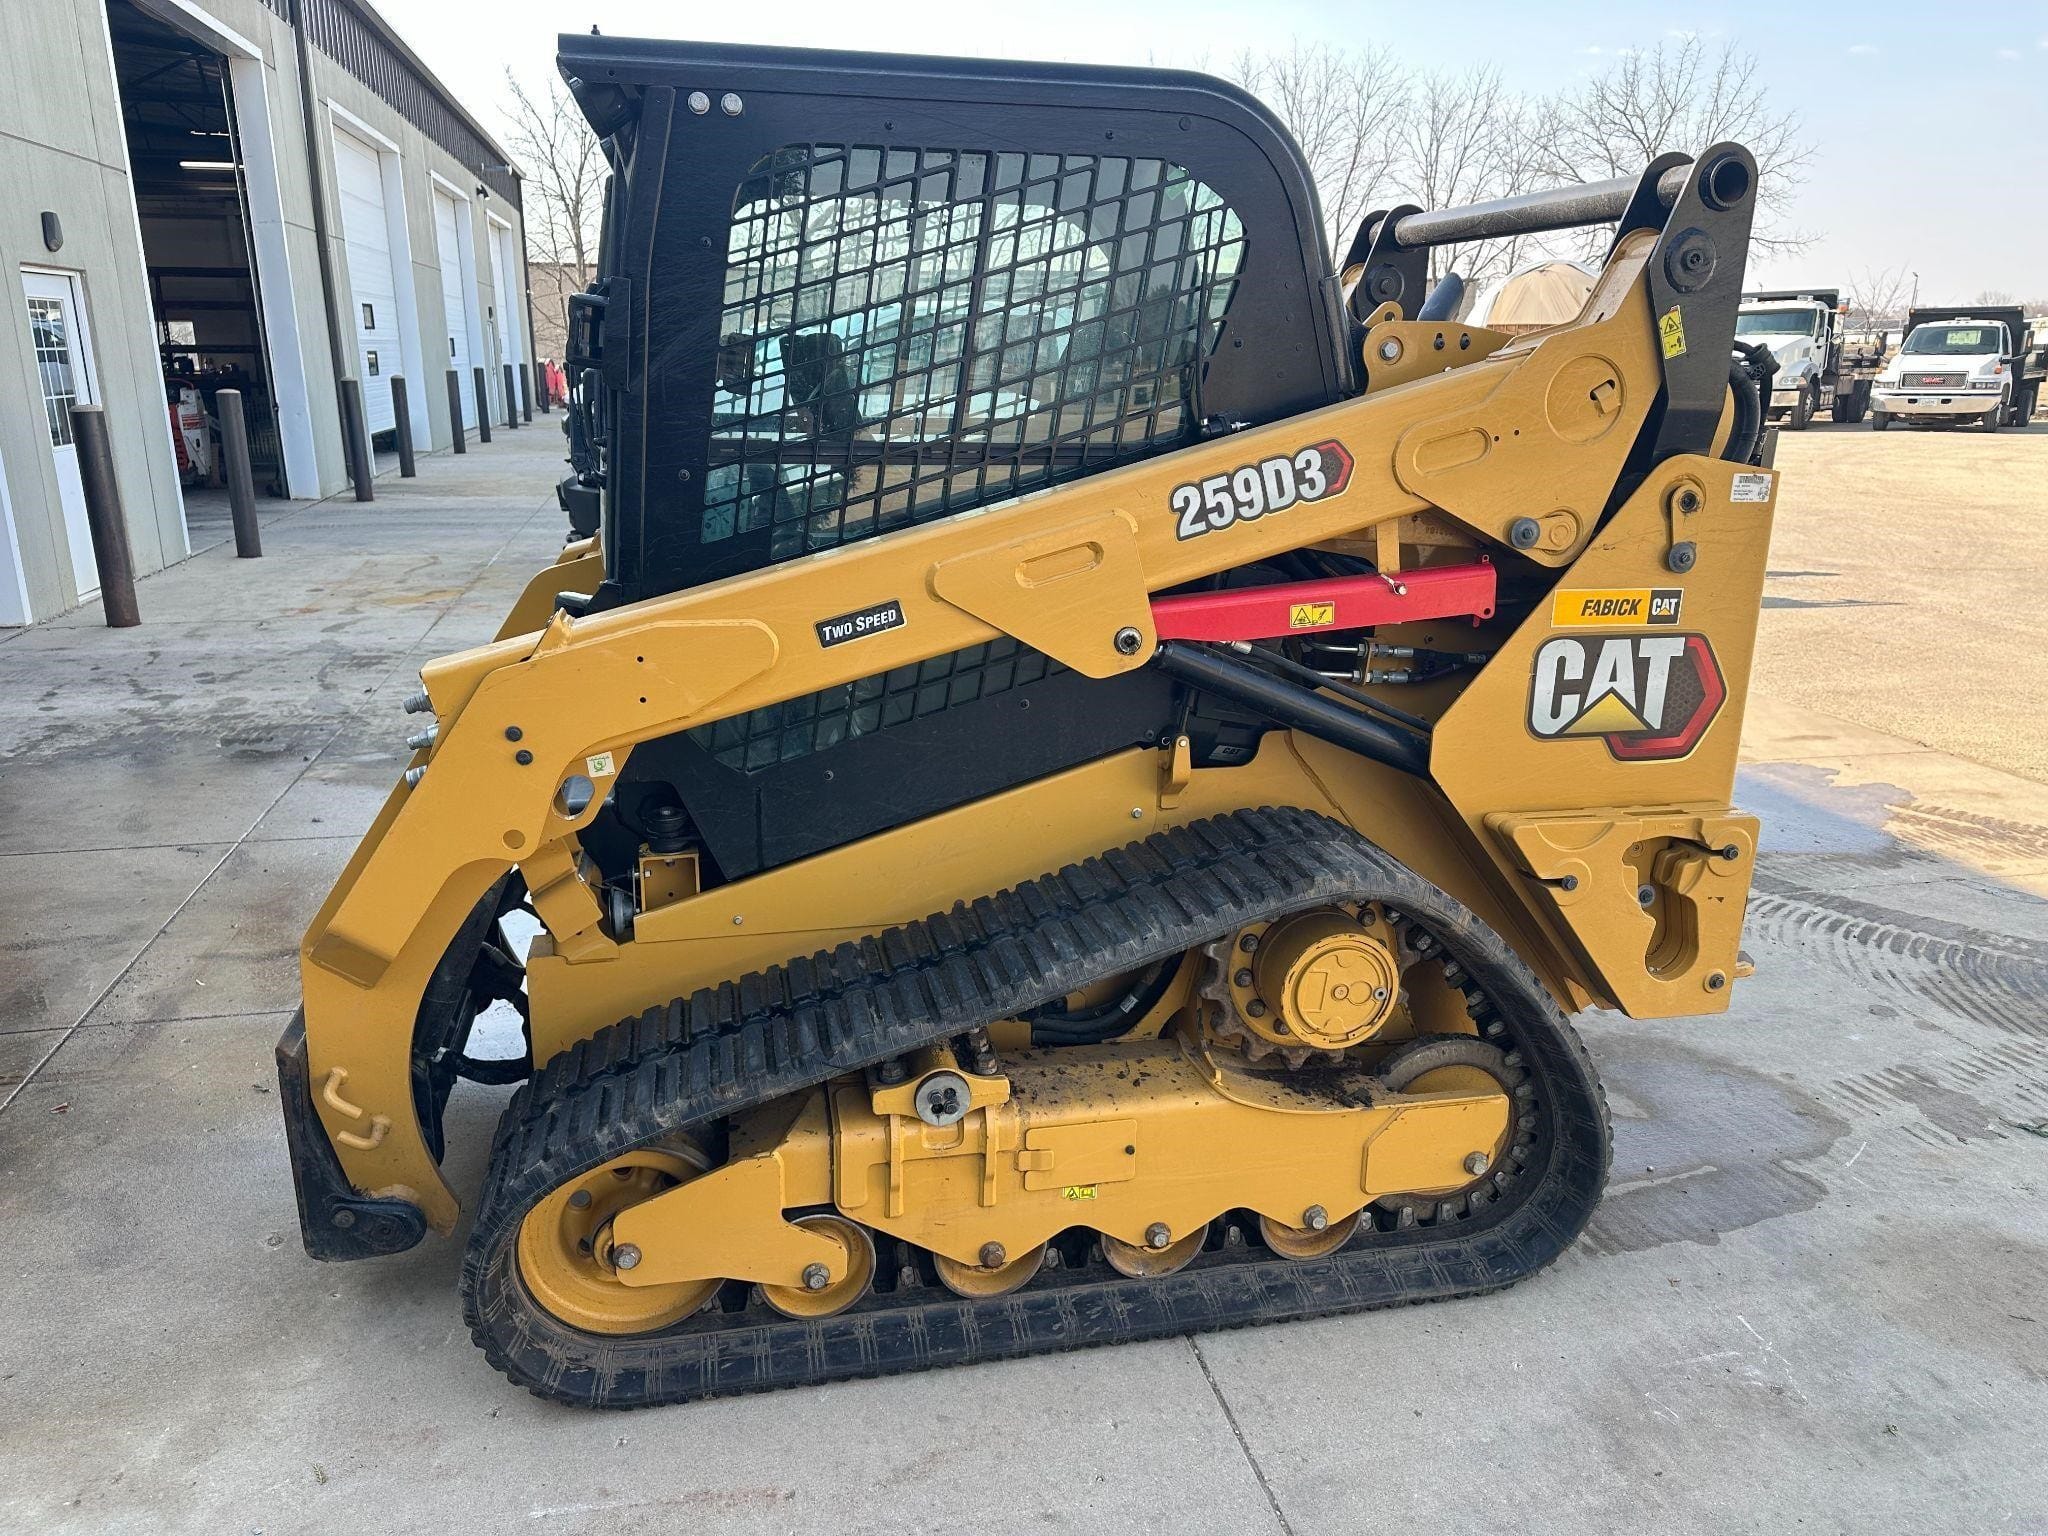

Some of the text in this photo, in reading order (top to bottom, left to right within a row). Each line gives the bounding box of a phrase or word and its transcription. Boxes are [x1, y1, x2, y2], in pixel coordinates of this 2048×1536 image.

[1172, 449, 1327, 538] 259D3
[856, 609, 896, 632] SPEED
[1581, 597, 1678, 616] FABICK CAT
[1532, 636, 1686, 735] CAT
